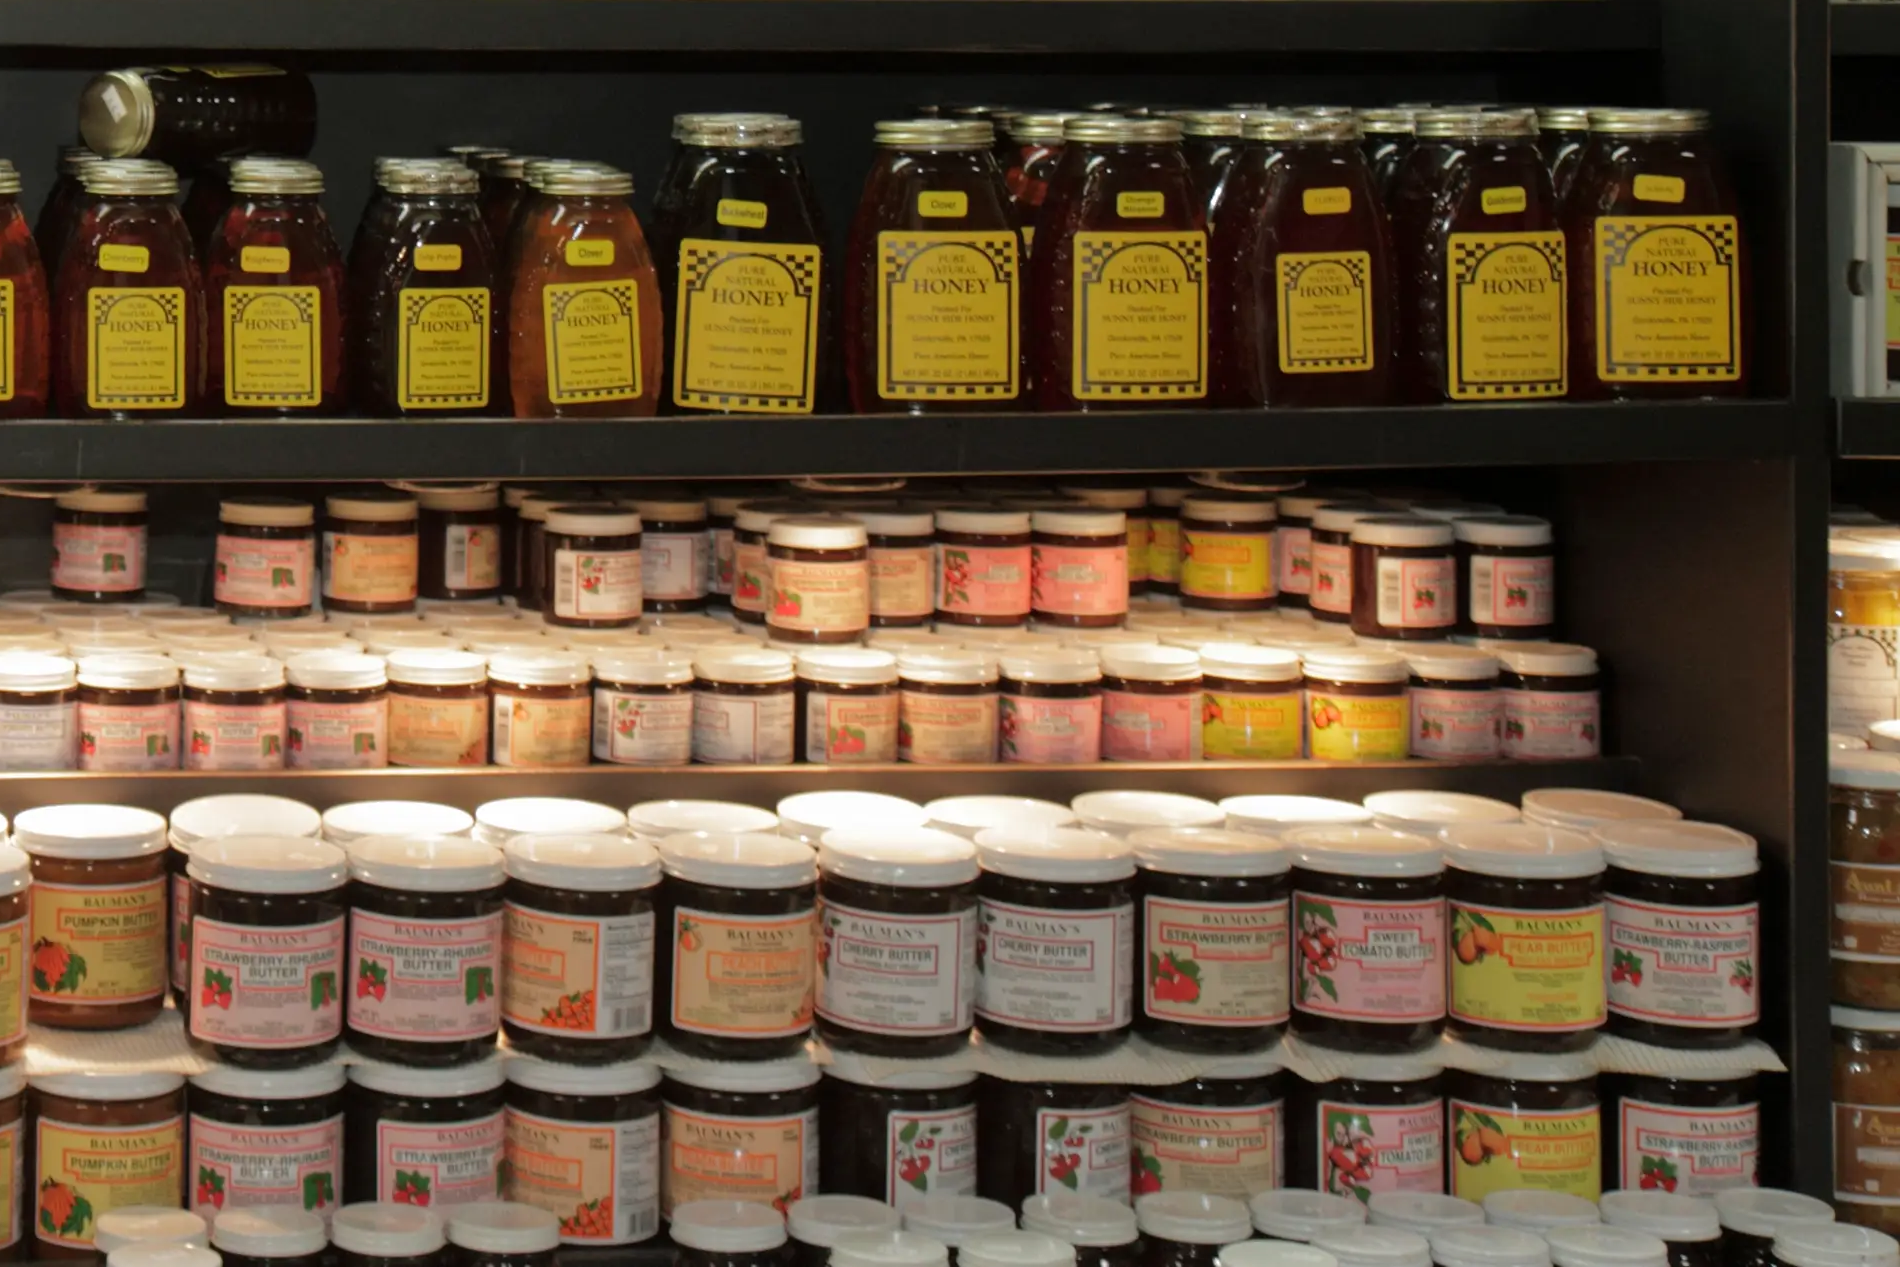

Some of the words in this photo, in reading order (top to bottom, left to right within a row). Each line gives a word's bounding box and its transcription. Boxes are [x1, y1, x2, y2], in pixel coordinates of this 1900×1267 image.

[1646, 247, 1696, 258] NATURAL
[926, 264, 977, 274] NATURAL
[1122, 265, 1170, 274] NATURAL
[1632, 261, 1711, 277] HONEY
[726, 276, 777, 287] NATURAL
[913, 278, 990, 295] HONEY
[1109, 279, 1182, 294] HONEY
[1482, 278, 1547, 295] HONEY
[712, 288, 790, 307] HONEY
[1300, 285, 1353, 298] HONEY
[109, 320, 164, 332] HONEY
[245, 318, 298, 331] HONEY
[421, 321, 471, 332] HONEY
[567, 314, 620, 327] HONEY
[64, 915, 120, 927] PUMPKIN
[124, 912, 158, 925] BUTTER
[1167, 930, 1252, 944] STRAWBERRY
[1373, 933, 1414, 943] SWEET
[360, 939, 491, 958] STRAWBERRY-RHUBARB
[843, 942, 884, 958] CHERRY
[889, 949, 932, 962] BUTTER
[998, 940, 1039, 955] CHERRY
[1044, 943, 1087, 956] BUTTER
[1344, 944, 1392, 958] TOMATO
[1397, 945, 1432, 958] BUTTER
[1509, 942, 1543, 953] PEAR
[1548, 942, 1589, 955] BUTTER
[205, 948, 336, 966] STRAWBERRY-RHUBARB
[1664, 953, 1709, 964] BUTTER
[403, 960, 451, 970] BUTTER
[249, 967, 298, 977] BUTTER
[1217, 1136, 1261, 1147] BUTTER
[1516, 1141, 1549, 1152] PEAR
[1554, 1141, 1592, 1154] BUTTER
[71, 1156, 128, 1170] PUMPKIN
[131, 1151, 171, 1168] BUTTER
[200, 1146, 330, 1165] STRAWBERRY-RHUBARB
[1381, 1149, 1424, 1162] TOMATO
[1700, 1156, 1738, 1167] BUTTER
[241, 1167, 288, 1178] BUTTER
[447, 1159, 488, 1174] BUTTER
